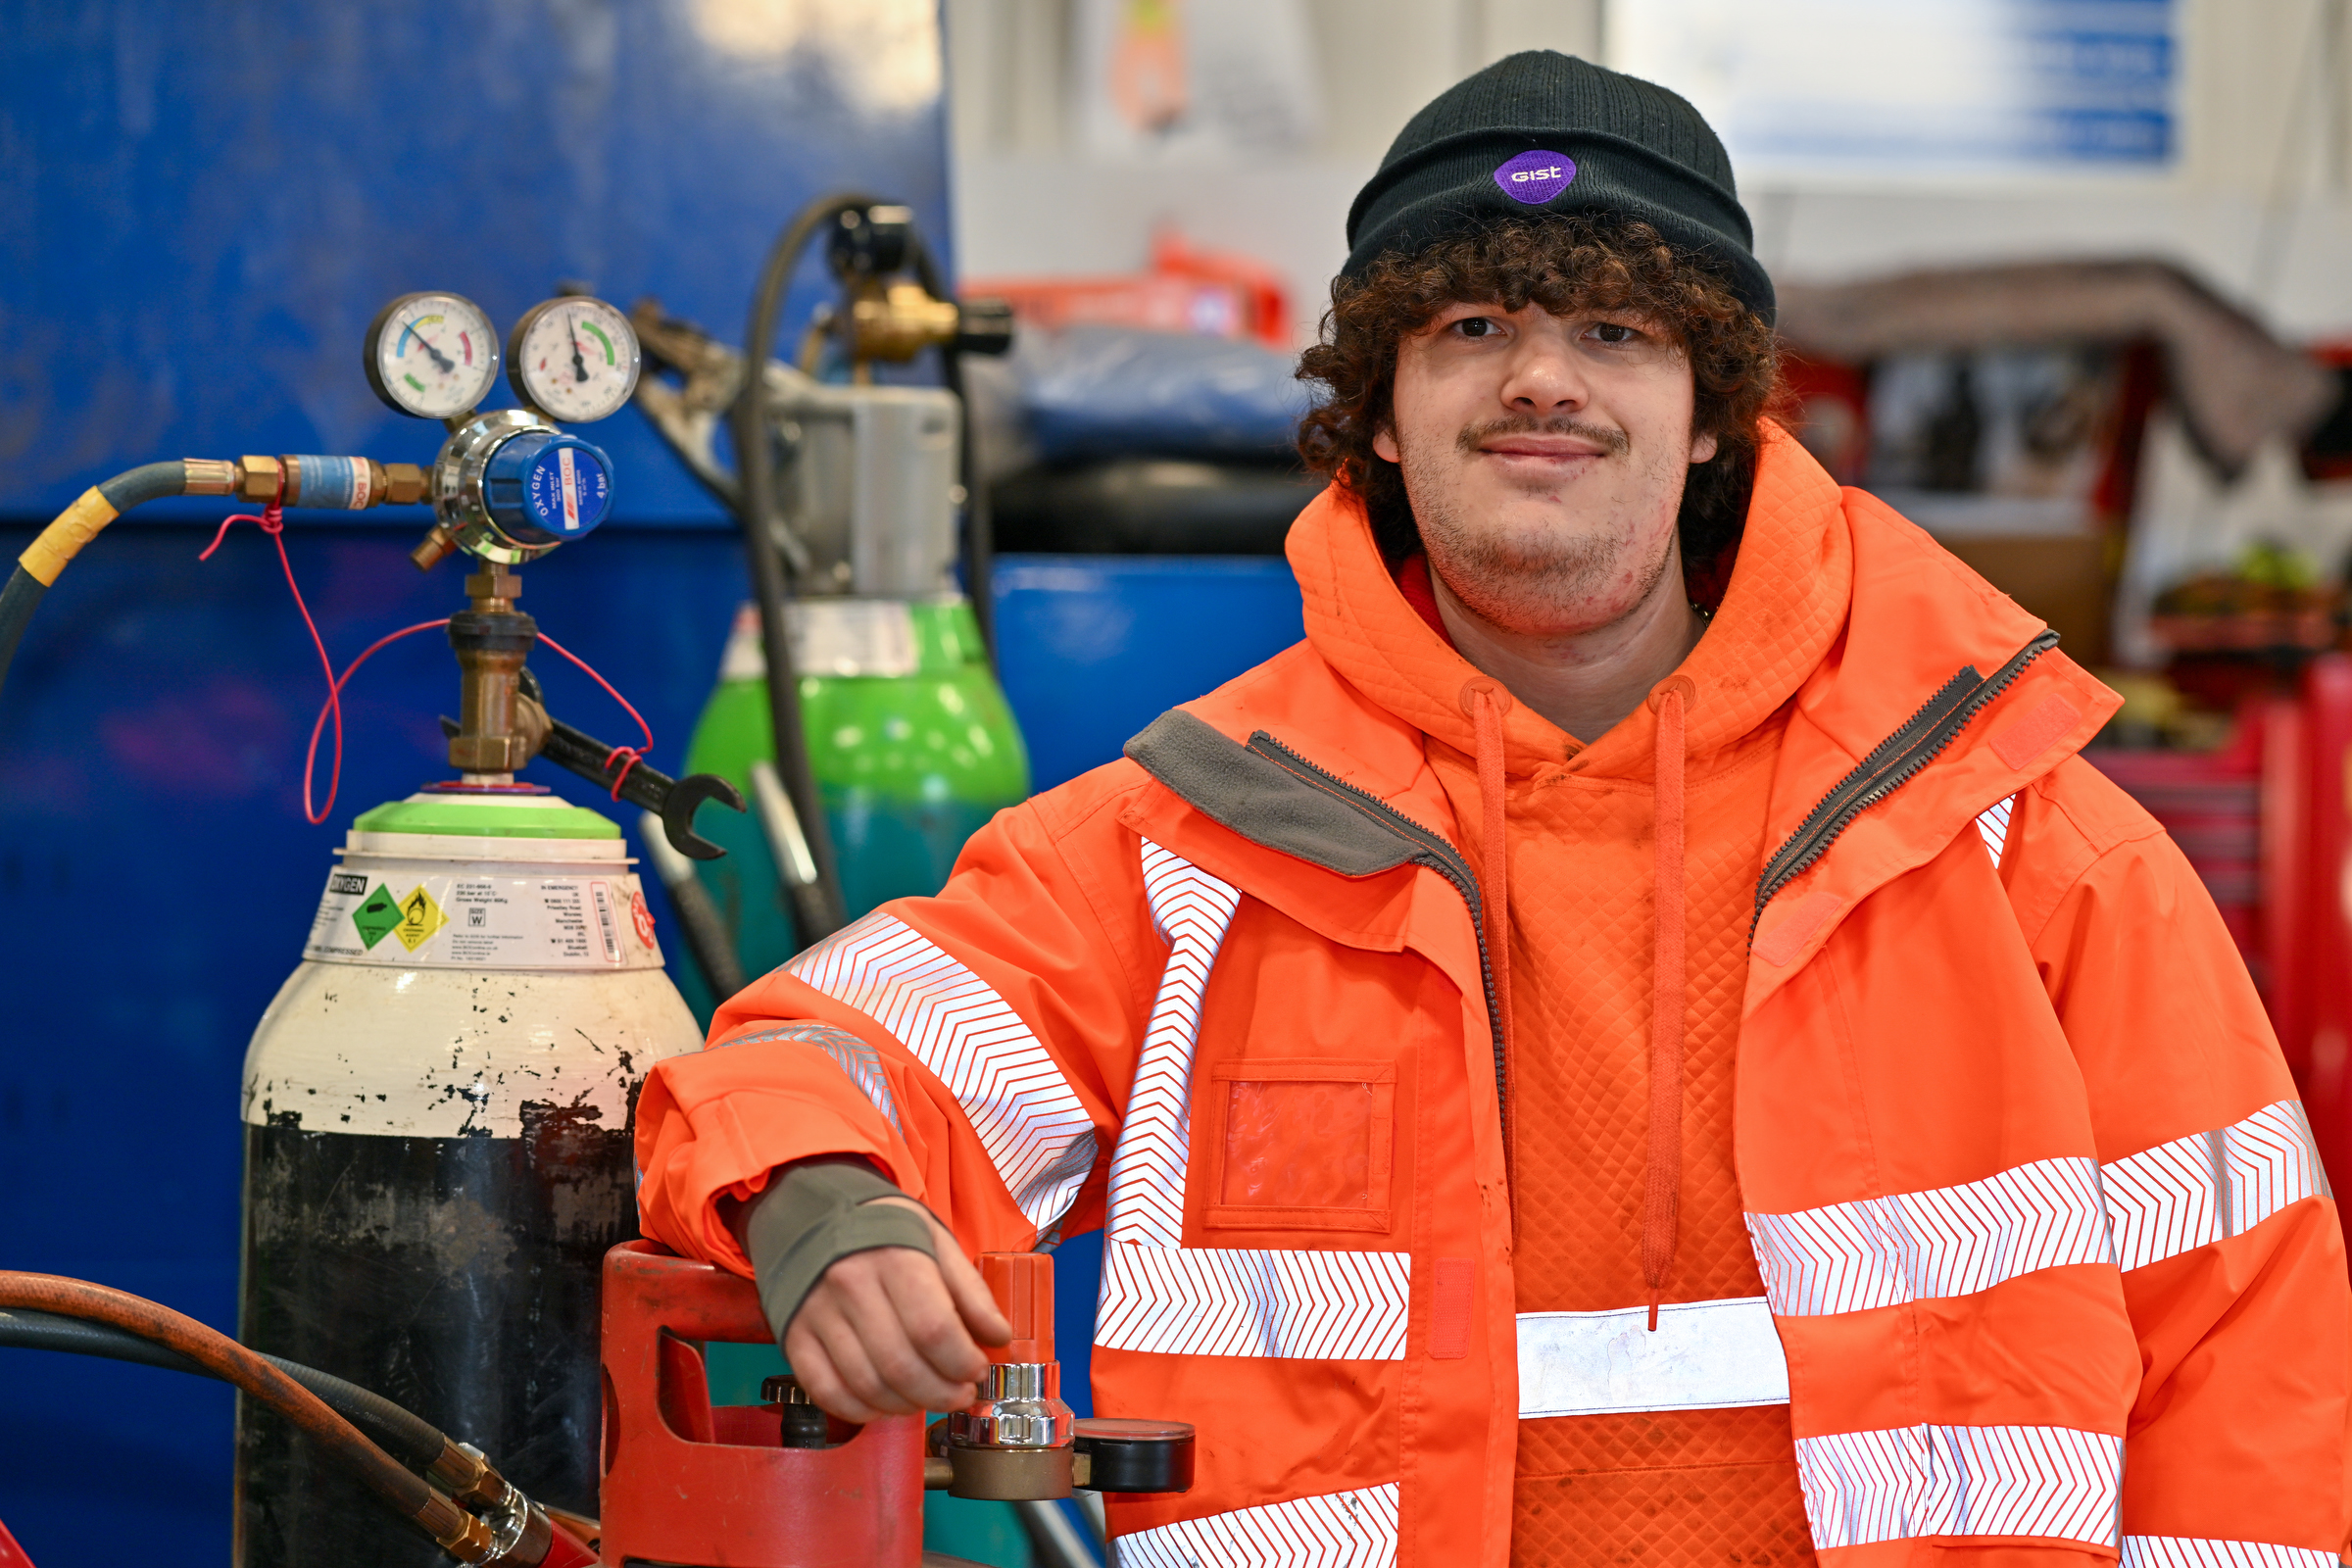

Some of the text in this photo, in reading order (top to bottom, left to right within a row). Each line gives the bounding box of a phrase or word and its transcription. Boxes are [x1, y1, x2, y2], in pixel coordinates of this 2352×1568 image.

[563, 457, 572, 486] BOC
[596, 473, 606, 489] bar
[354, 482, 368, 508] BOC
[531, 465, 549, 516] OXYGEN
[331, 876, 365, 893] OXYGEN
